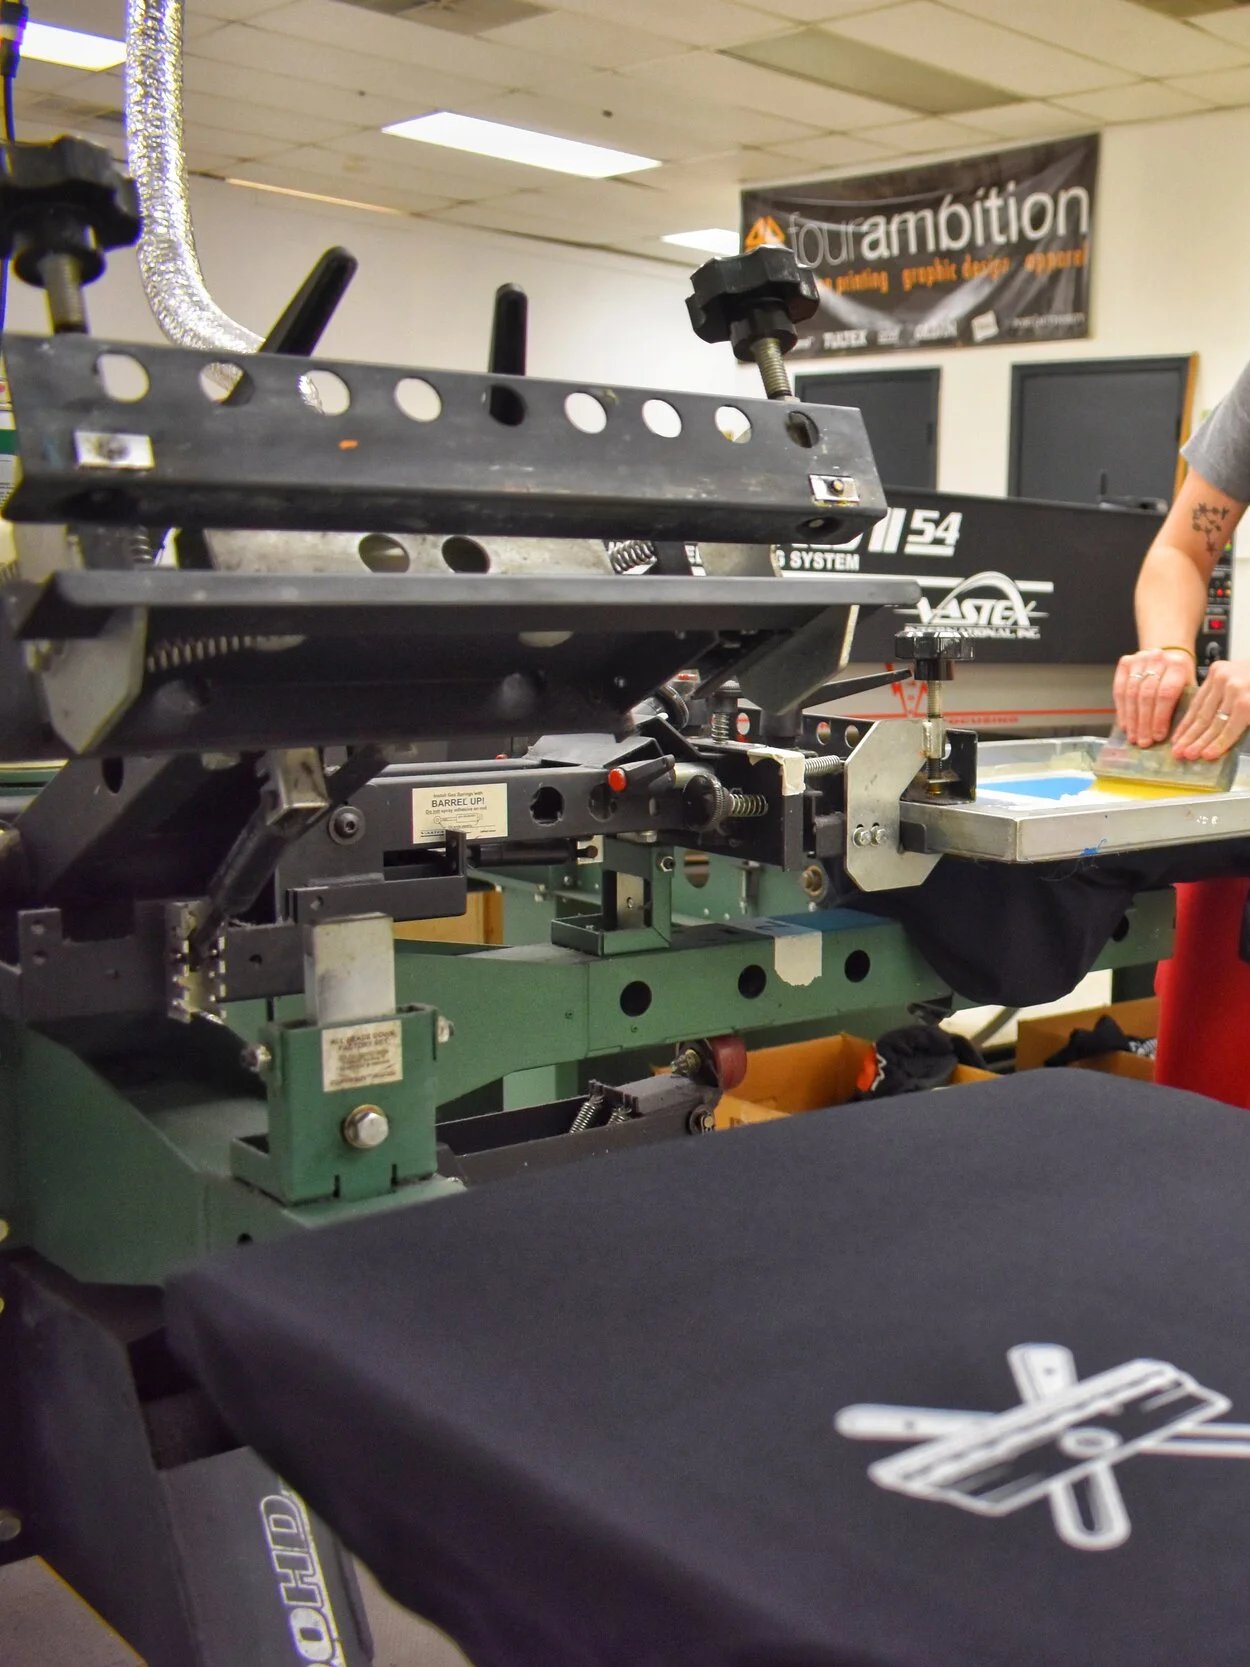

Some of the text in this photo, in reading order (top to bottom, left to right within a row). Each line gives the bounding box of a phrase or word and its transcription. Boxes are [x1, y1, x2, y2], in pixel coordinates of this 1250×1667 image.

[835, 238, 1089, 295] printing graphic design apparel
[906, 508, 963, 545] 54
[790, 551, 860, 571] SYSTEM
[916, 571, 1038, 626] VASTEX
[431, 797, 485, 808] BARREL UP!
